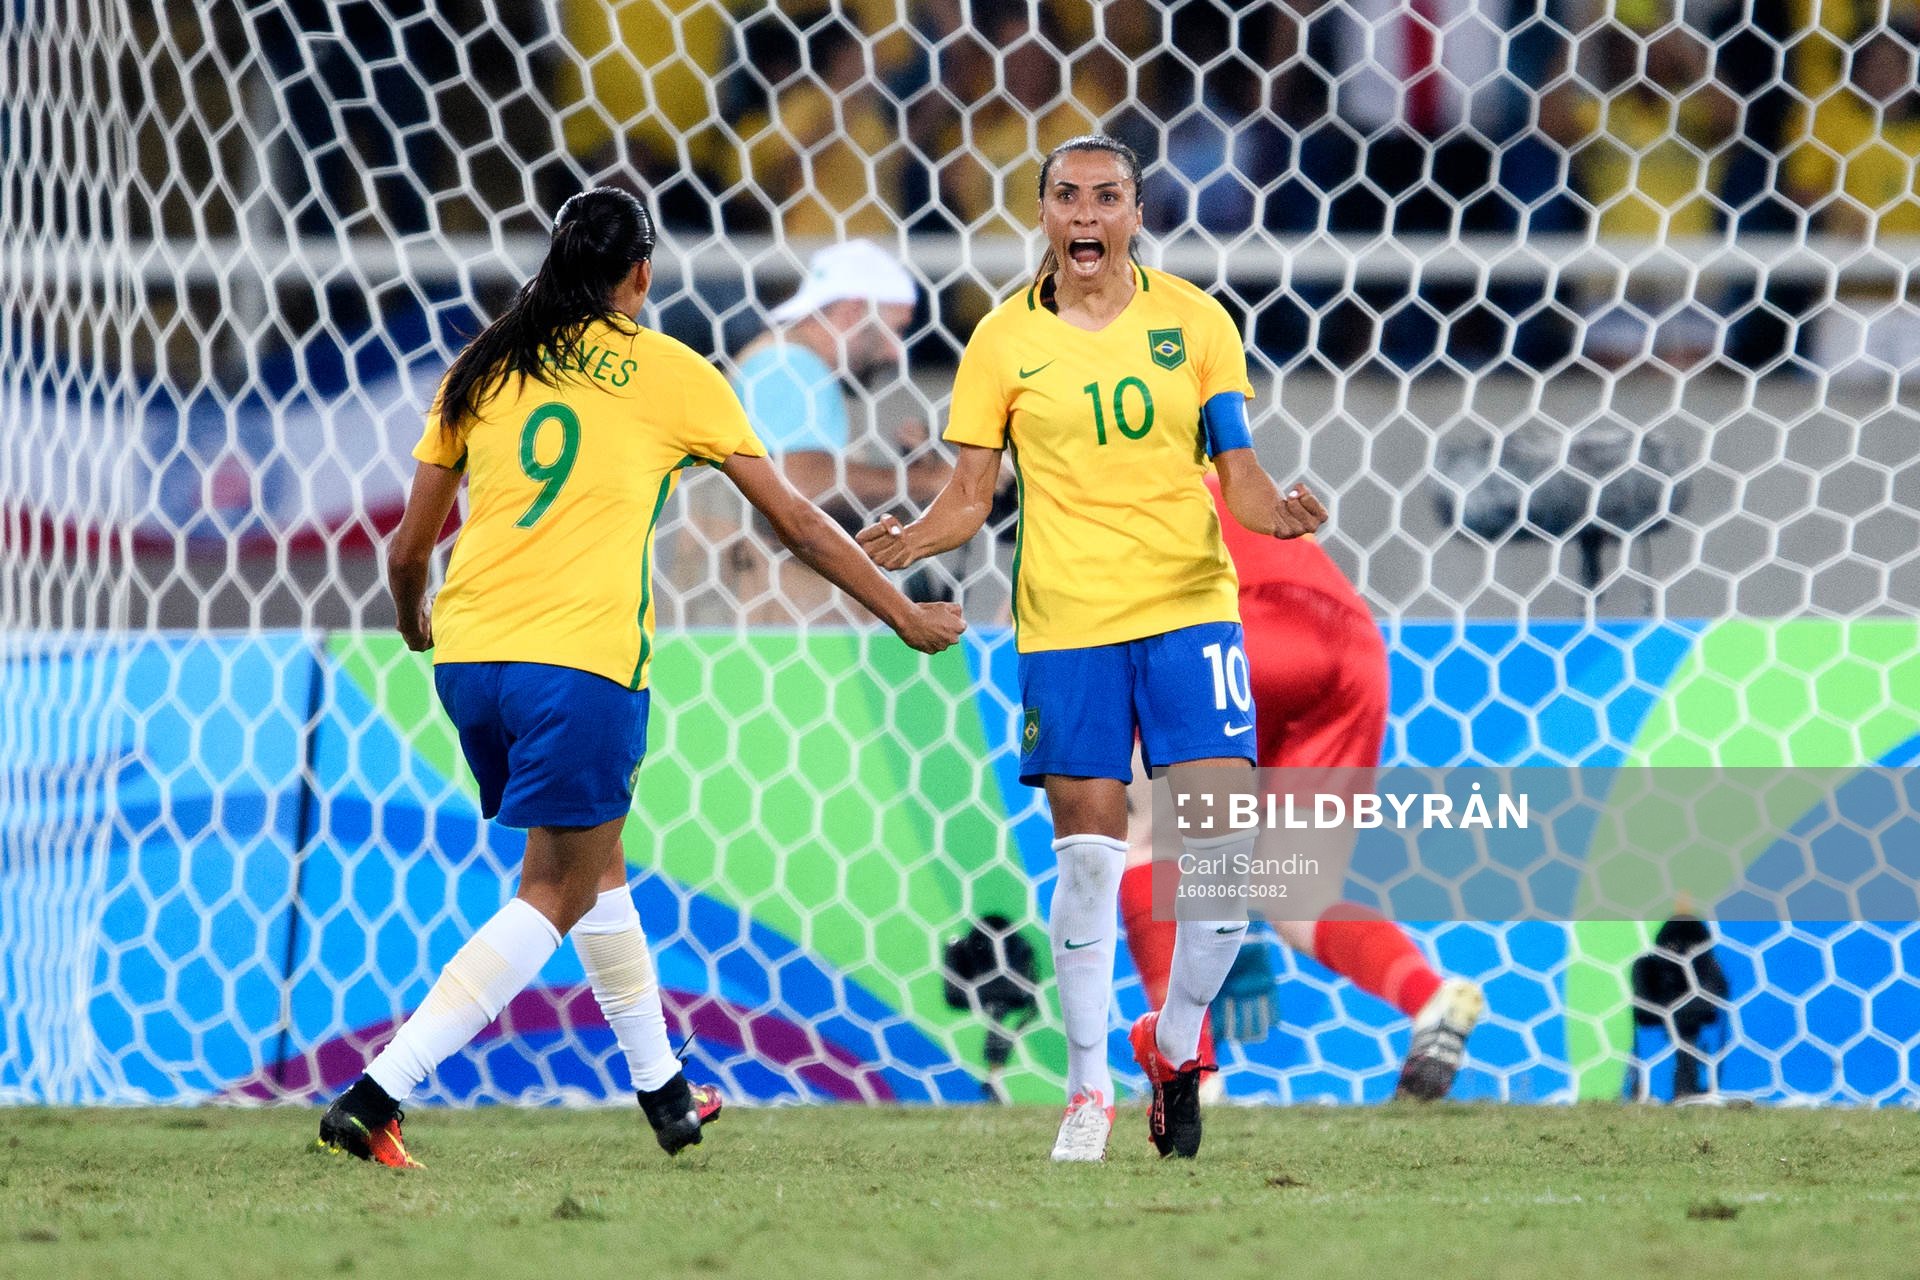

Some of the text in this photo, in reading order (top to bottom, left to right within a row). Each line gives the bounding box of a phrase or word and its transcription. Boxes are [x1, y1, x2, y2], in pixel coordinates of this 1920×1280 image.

[1083, 376, 1154, 446] 10
[512, 401, 582, 529] 9
[1203, 642, 1251, 712] 10
